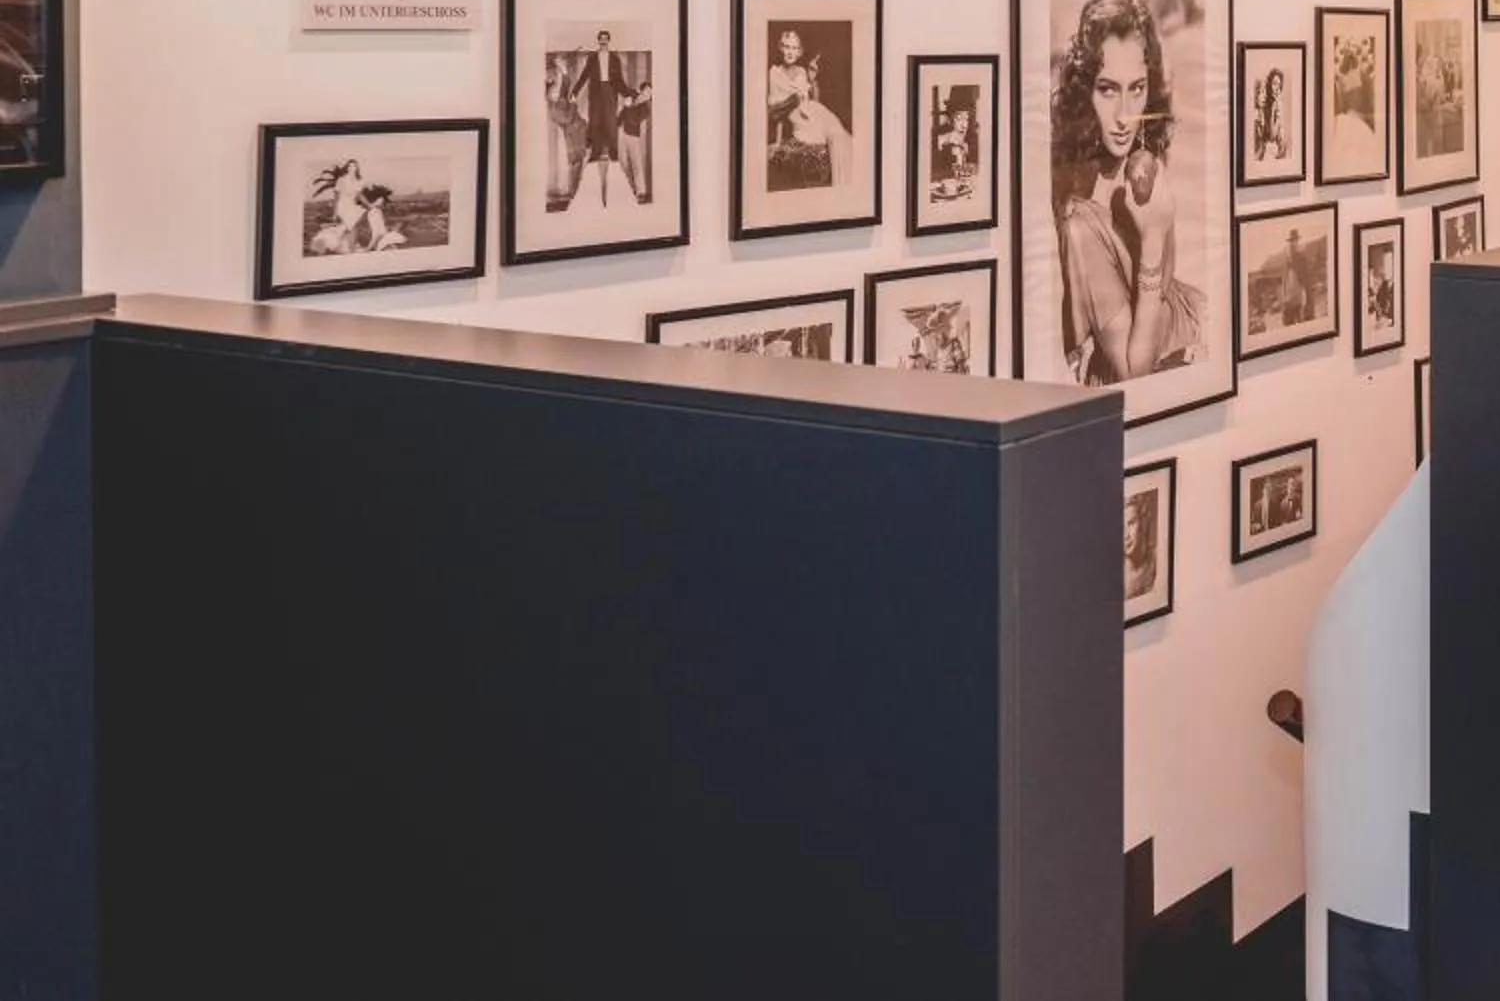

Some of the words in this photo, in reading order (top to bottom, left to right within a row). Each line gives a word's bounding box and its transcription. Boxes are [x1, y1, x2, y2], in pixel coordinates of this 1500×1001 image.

[314, 4, 336, 18] WC
[339, 4, 356, 18] IM
[359, 4, 467, 18] UNTERGESCHOSS
